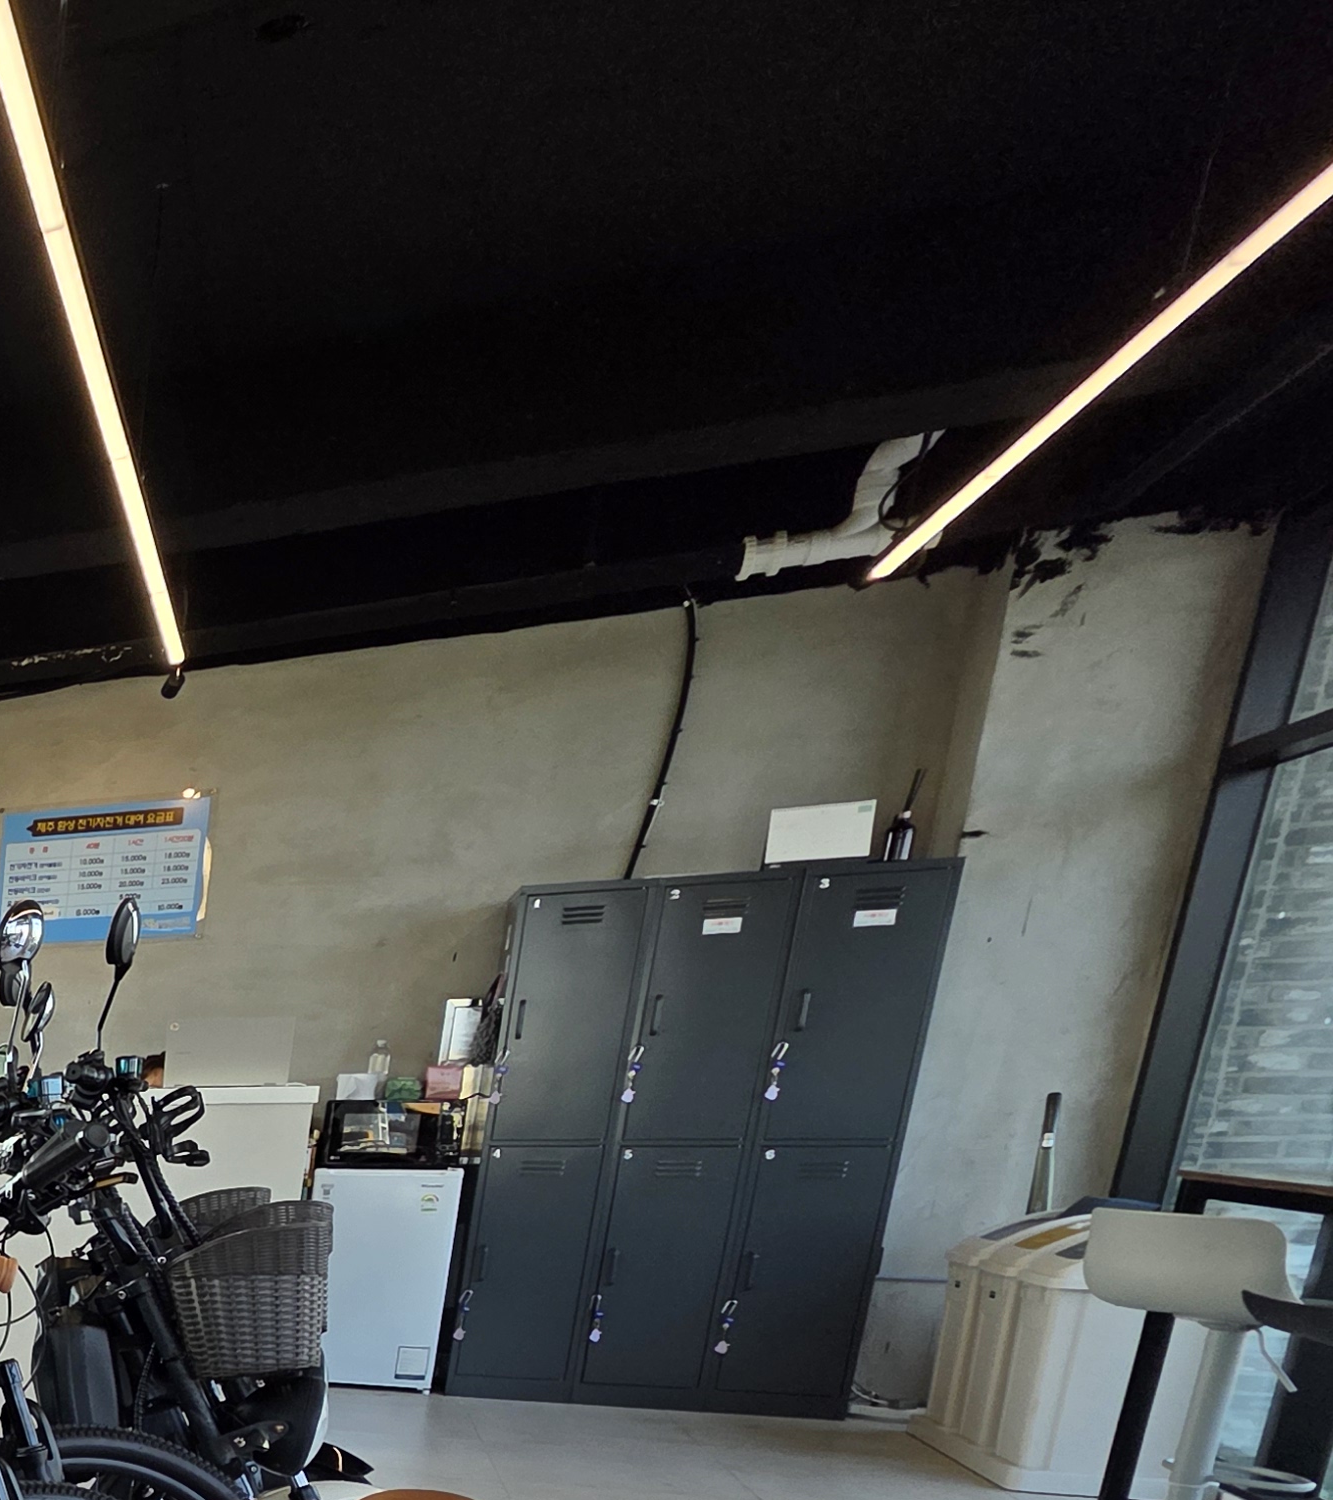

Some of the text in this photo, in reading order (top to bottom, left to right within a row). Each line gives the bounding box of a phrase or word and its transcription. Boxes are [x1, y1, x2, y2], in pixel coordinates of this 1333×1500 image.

[77, 815, 123, 829] 전기자전거
[125, 813, 144, 825] 대여
[146, 811, 175, 823] 요금표
[819, 877, 830, 889] 3
[669, 888, 681, 900] 2
